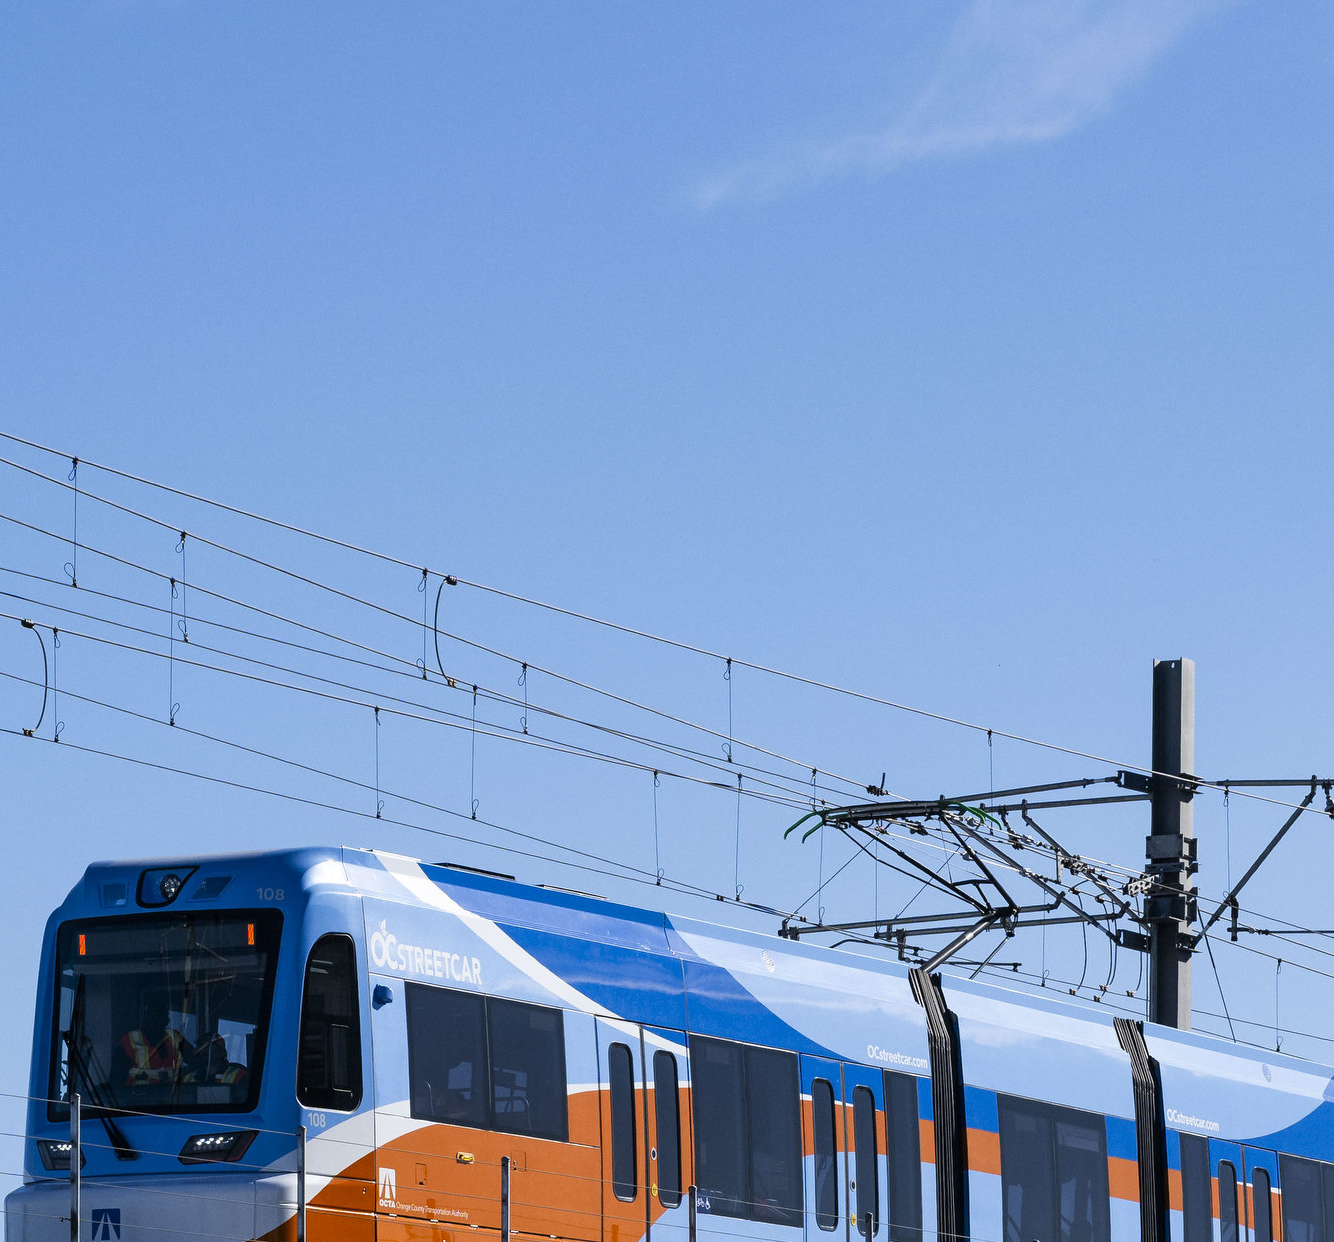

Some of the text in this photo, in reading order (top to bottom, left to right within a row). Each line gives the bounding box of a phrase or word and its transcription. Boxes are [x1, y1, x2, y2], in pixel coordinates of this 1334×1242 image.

[256, 887, 284, 901] 108
[867, 1044, 928, 1069] OCstreetcar.com
[308, 1112, 326, 1128] 108
[1166, 1108, 1220, 1132] OCstreetcar.com
[379, 1199, 396, 1209] OCTA
